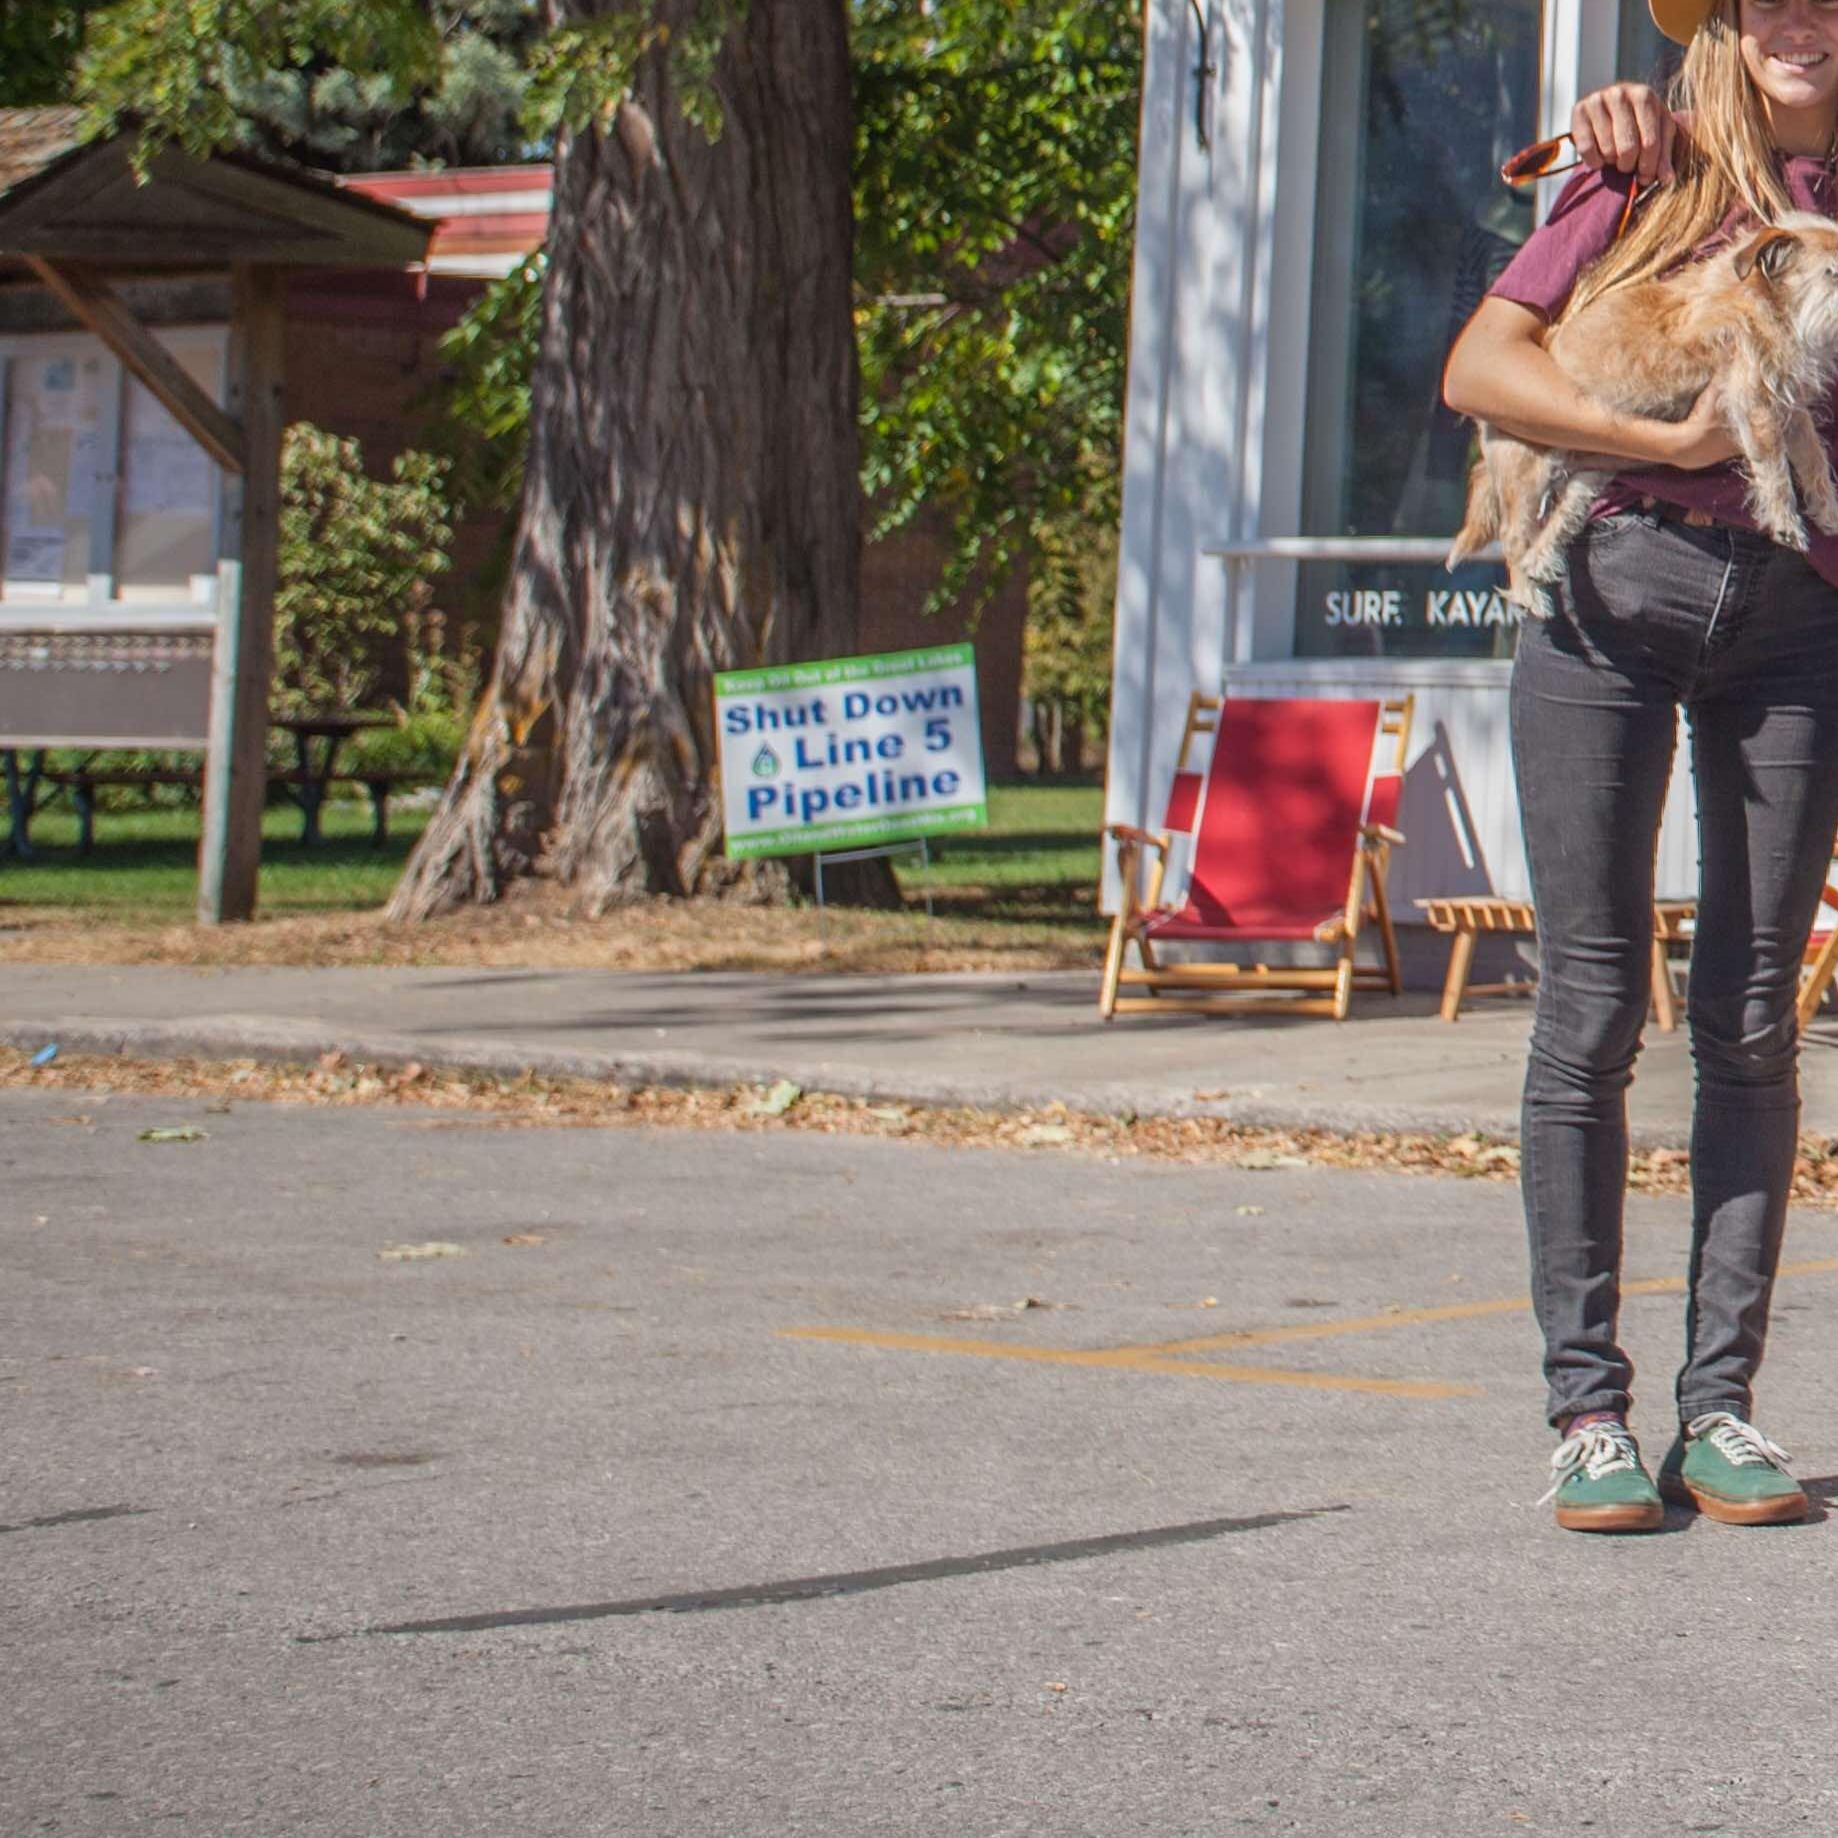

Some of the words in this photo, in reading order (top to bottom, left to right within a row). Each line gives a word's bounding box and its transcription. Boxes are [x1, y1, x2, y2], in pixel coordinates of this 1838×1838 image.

[1325, 590, 1402, 626] SURF.
[725, 697, 828, 735] Shut
[843, 682, 965, 721] Down
[794, 732, 905, 771] Line
[923, 717, 953, 752] 5
[746, 769, 961, 824] Pipeline
